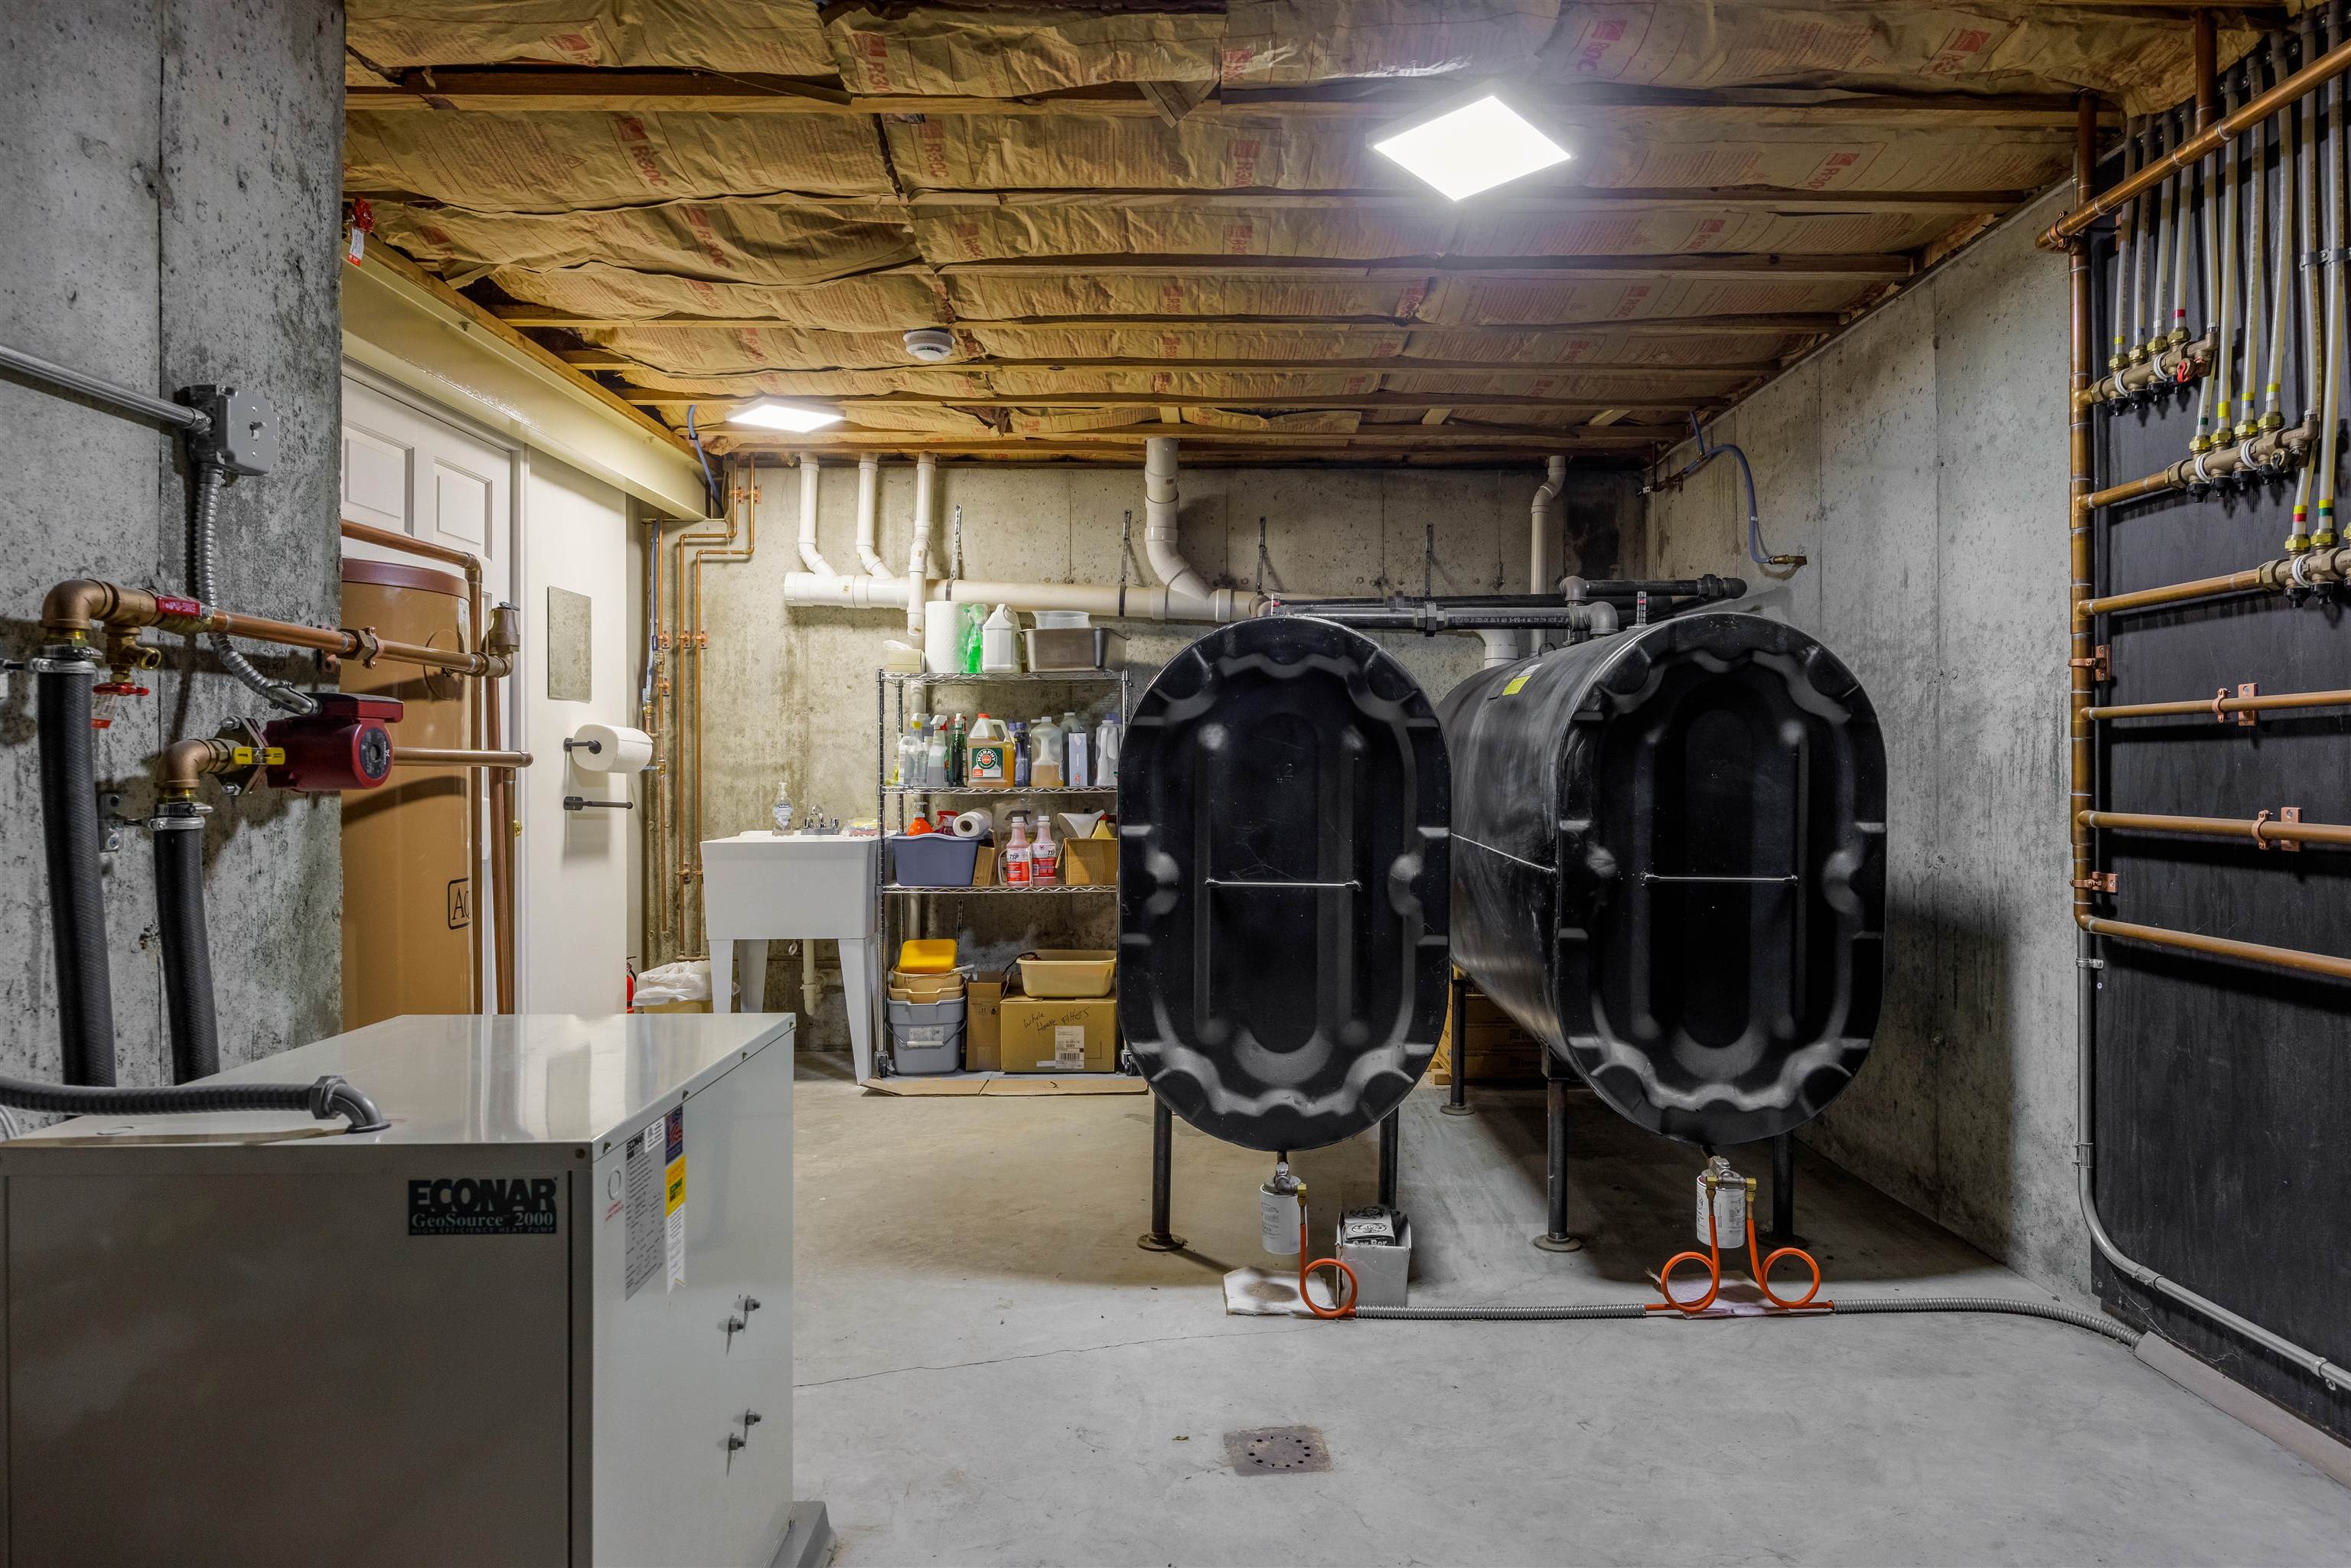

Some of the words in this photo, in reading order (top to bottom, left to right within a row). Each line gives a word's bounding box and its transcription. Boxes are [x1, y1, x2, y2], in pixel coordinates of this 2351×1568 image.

[977, 750, 996, 762] MURPHY
[1023, 1011, 1045, 1028] Whole
[409, 1178, 557, 1213] ECONAR
[412, 1214, 504, 1227] GeoSource
[514, 1213, 554, 1226] 2000
